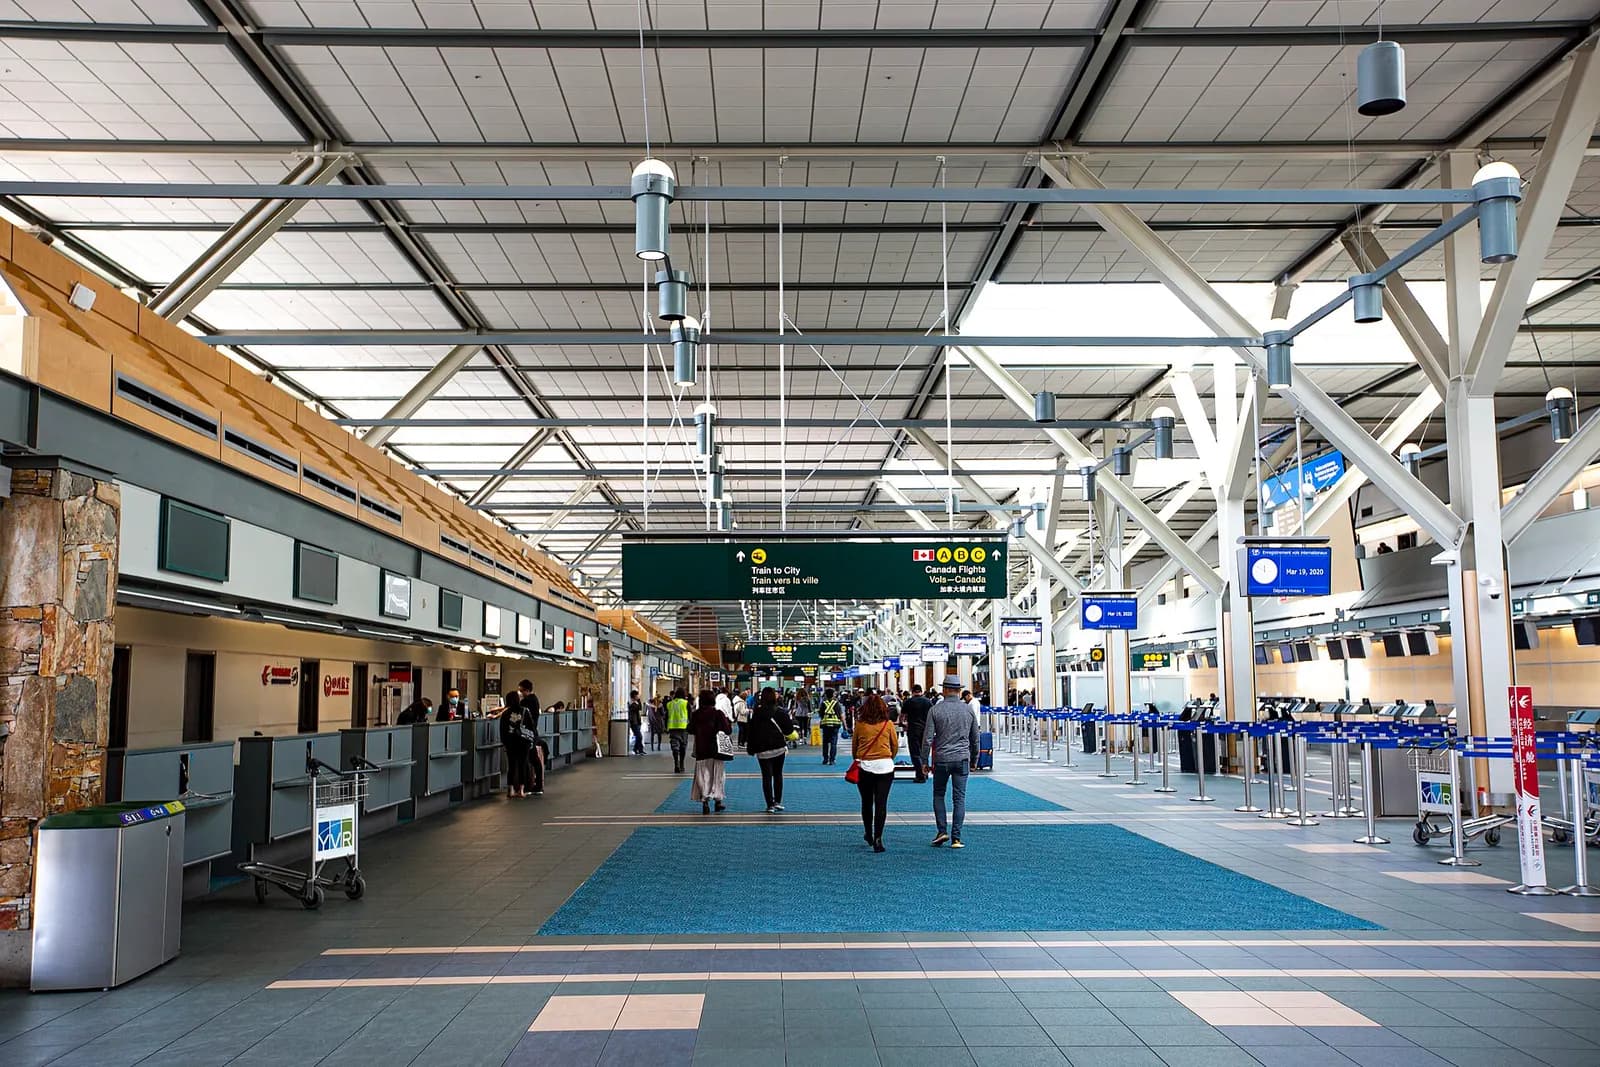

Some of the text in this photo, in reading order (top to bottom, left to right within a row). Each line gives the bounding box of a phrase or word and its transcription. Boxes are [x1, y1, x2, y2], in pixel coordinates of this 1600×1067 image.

[751, 566, 800, 576] Train to City
[925, 565, 986, 575] Canada Flights
[1286, 568, 1324, 577] Mar 19, 2020
[751, 576, 772, 584] Train
[792, 576, 800, 584] la
[802, 576, 819, 584] ville
[1421, 791, 1452, 806] YVR
[318, 831, 352, 851] YVR
